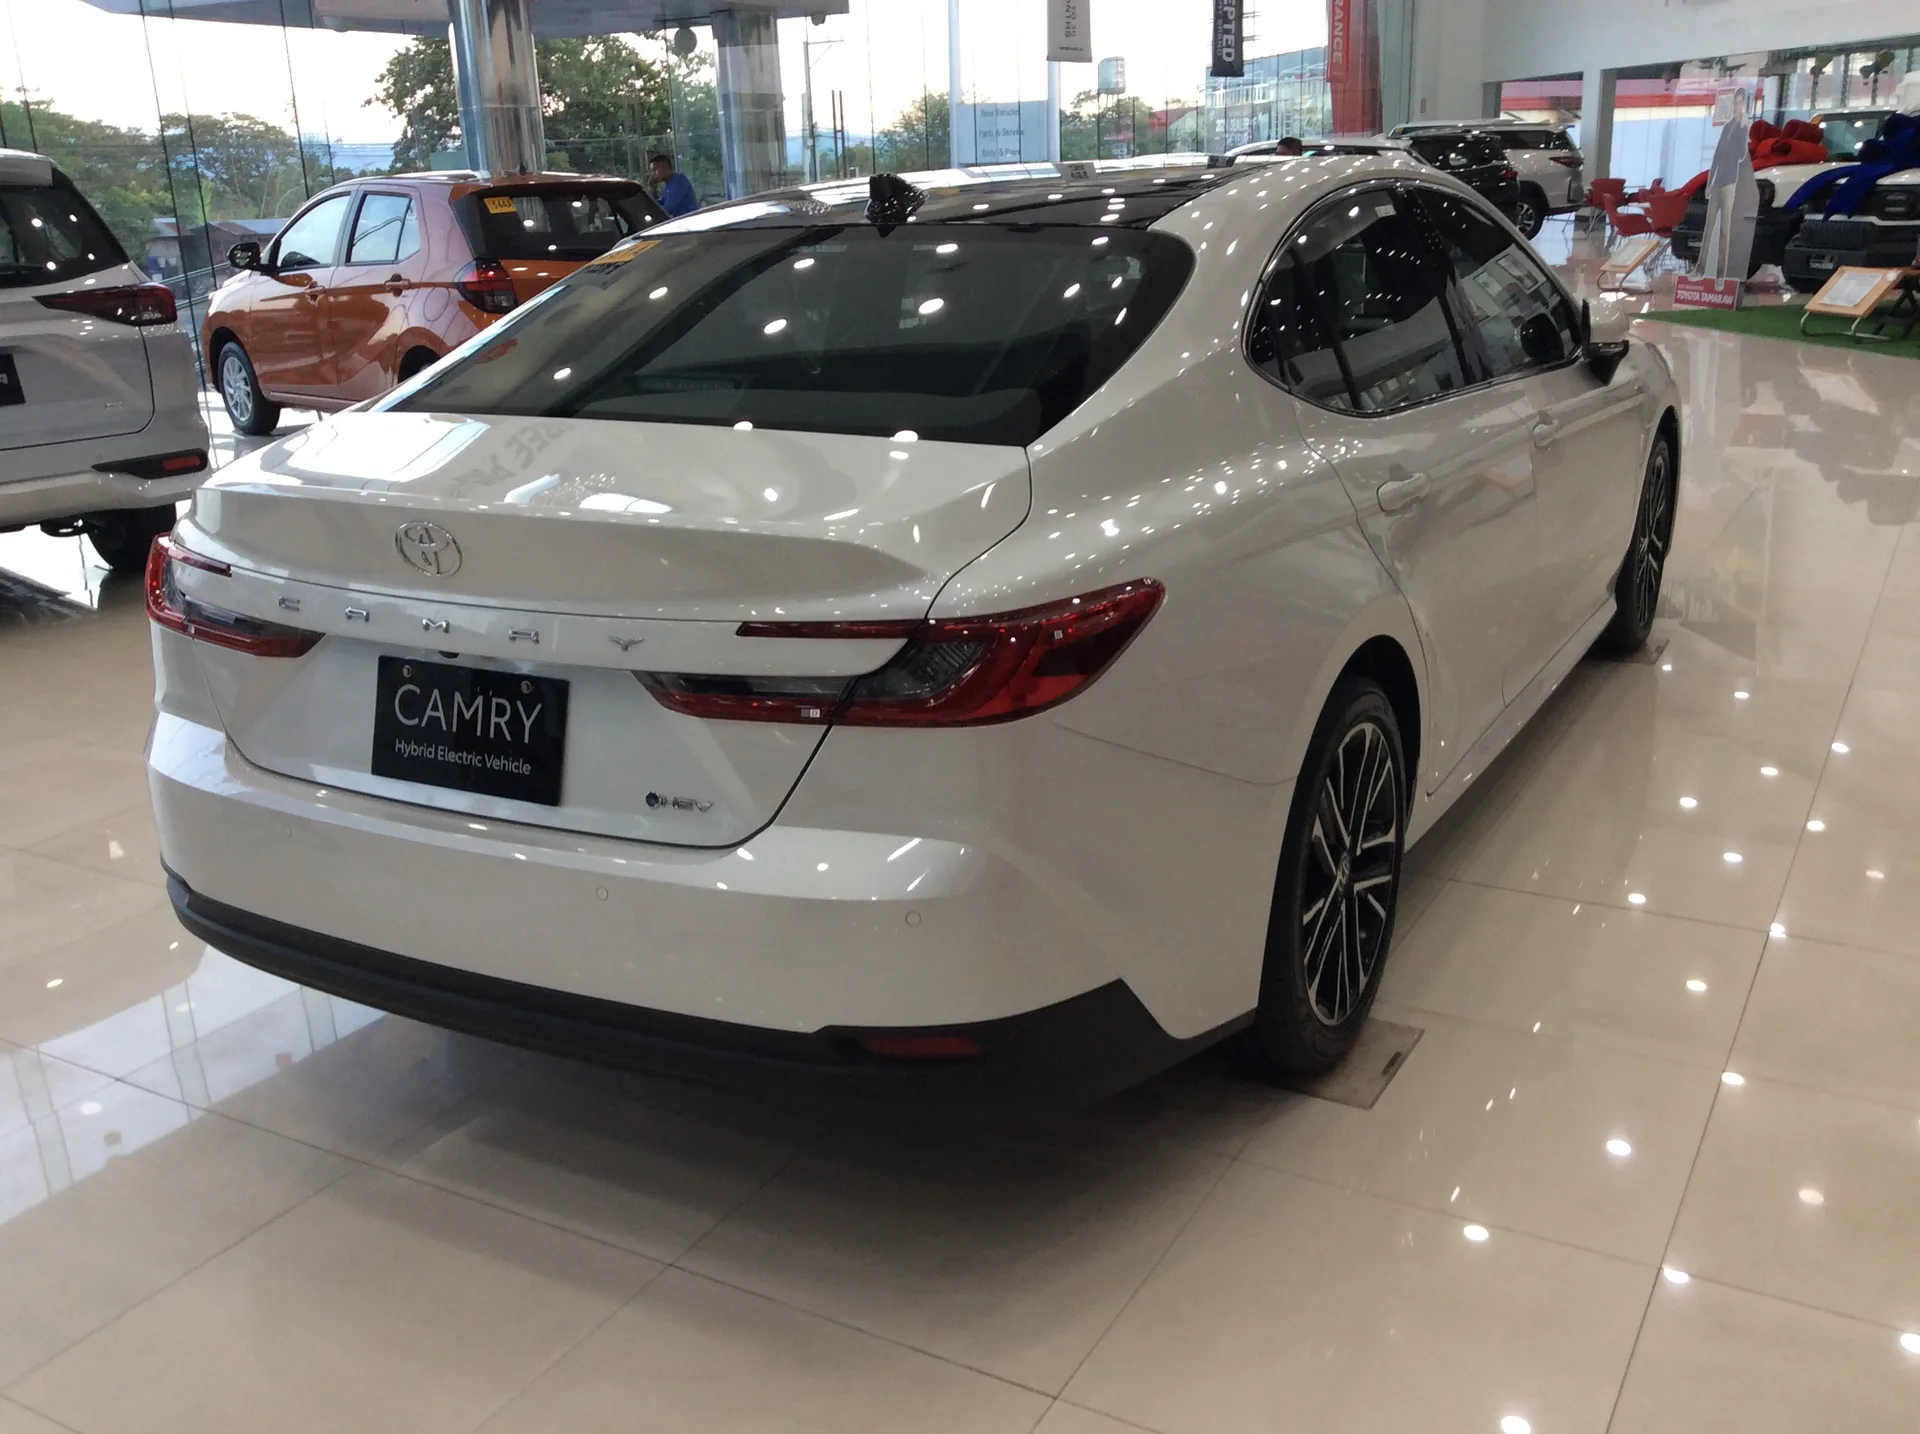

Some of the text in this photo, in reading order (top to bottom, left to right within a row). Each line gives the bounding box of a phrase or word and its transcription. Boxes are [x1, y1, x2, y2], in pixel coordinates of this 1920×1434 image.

[995, 107, 1021, 117] Vehicle
[1005, 147, 1021, 157] Pain
[1676, 289, 1700, 302] TOYOTA
[278, 596, 646, 652] CAMRY
[394, 683, 543, 745] CAMRY
[395, 738, 532, 775] Hybrid Electric Vehicle
